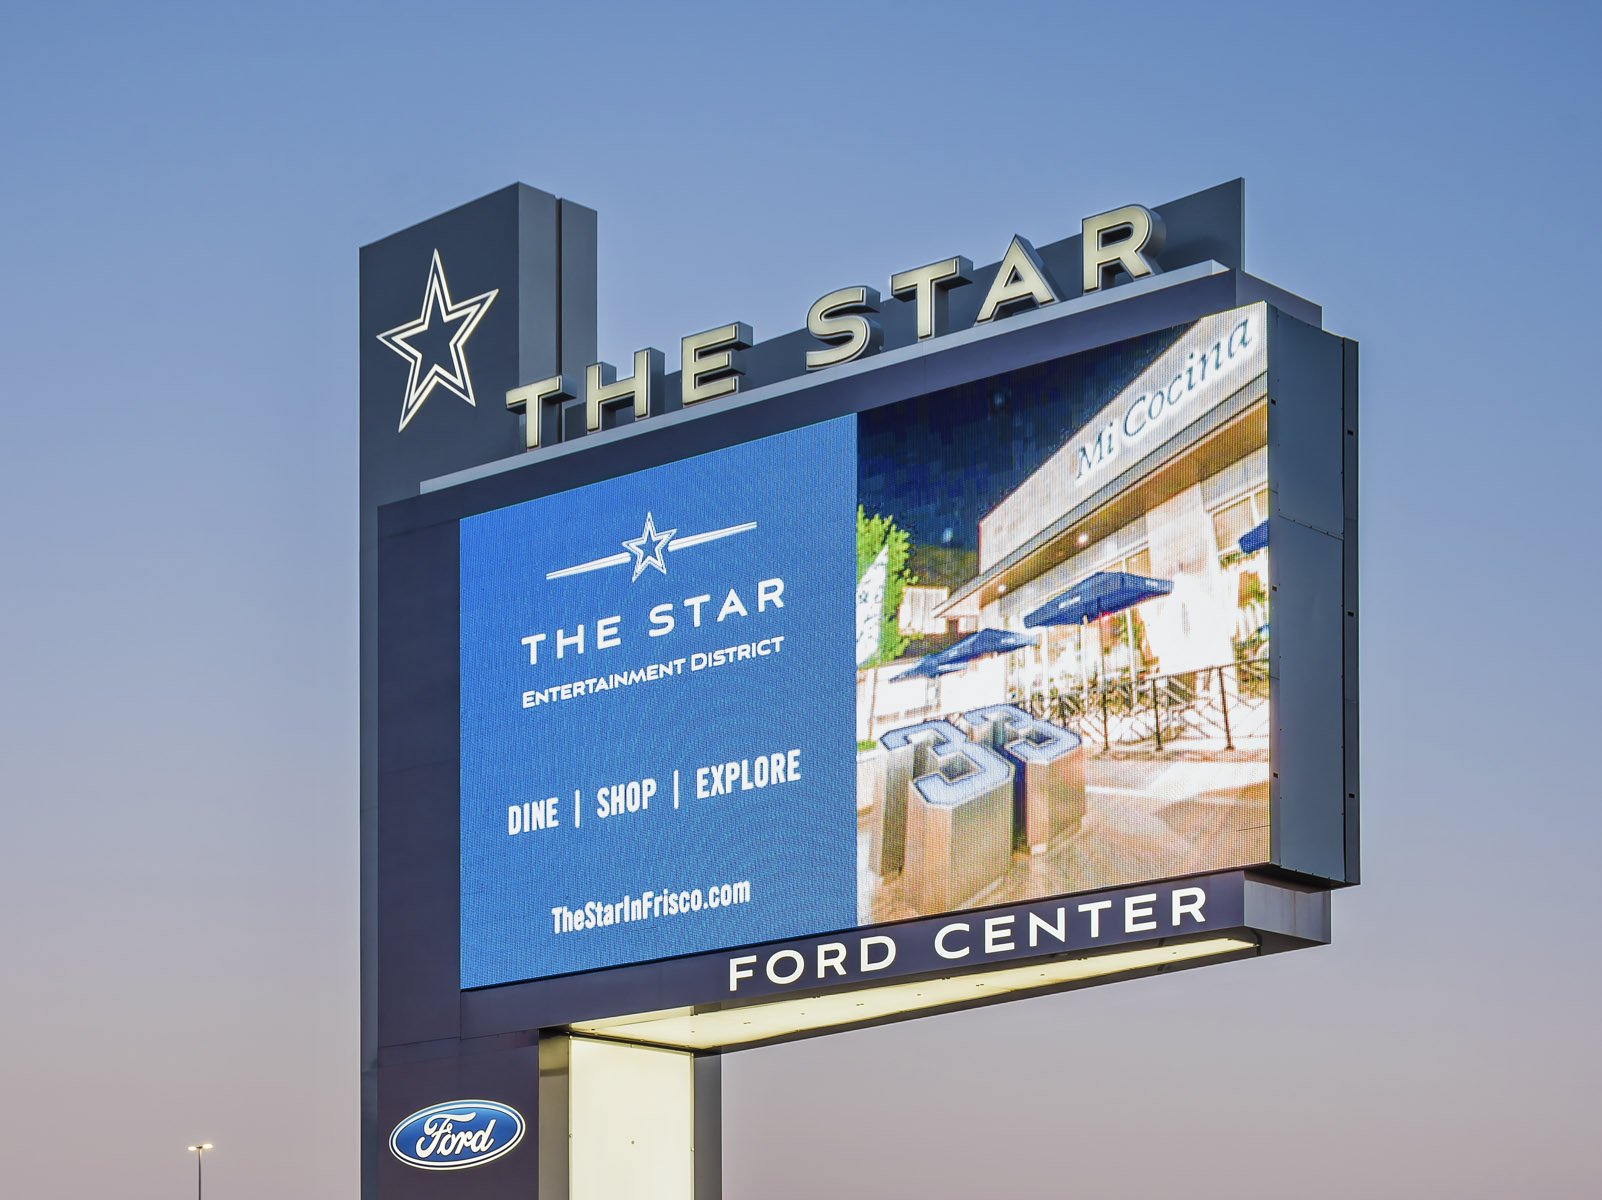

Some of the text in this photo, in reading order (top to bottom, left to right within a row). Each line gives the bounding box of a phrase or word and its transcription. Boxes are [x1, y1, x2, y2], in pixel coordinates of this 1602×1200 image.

[505, 203, 1160, 449] THE STAR
[1076, 318, 1253, 479] Mi Cocina
[520, 577, 785, 665] THE STAR
[521, 636, 785, 709] ENTERTAINMENT DISTRICT
[507, 748, 802, 836] DINE SHOP EXPLORE
[551, 880, 751, 935] TheStarInFrisco.com
[728, 886, 1207, 992] FORD CENTER
[415, 1111, 497, 1158] Ford
